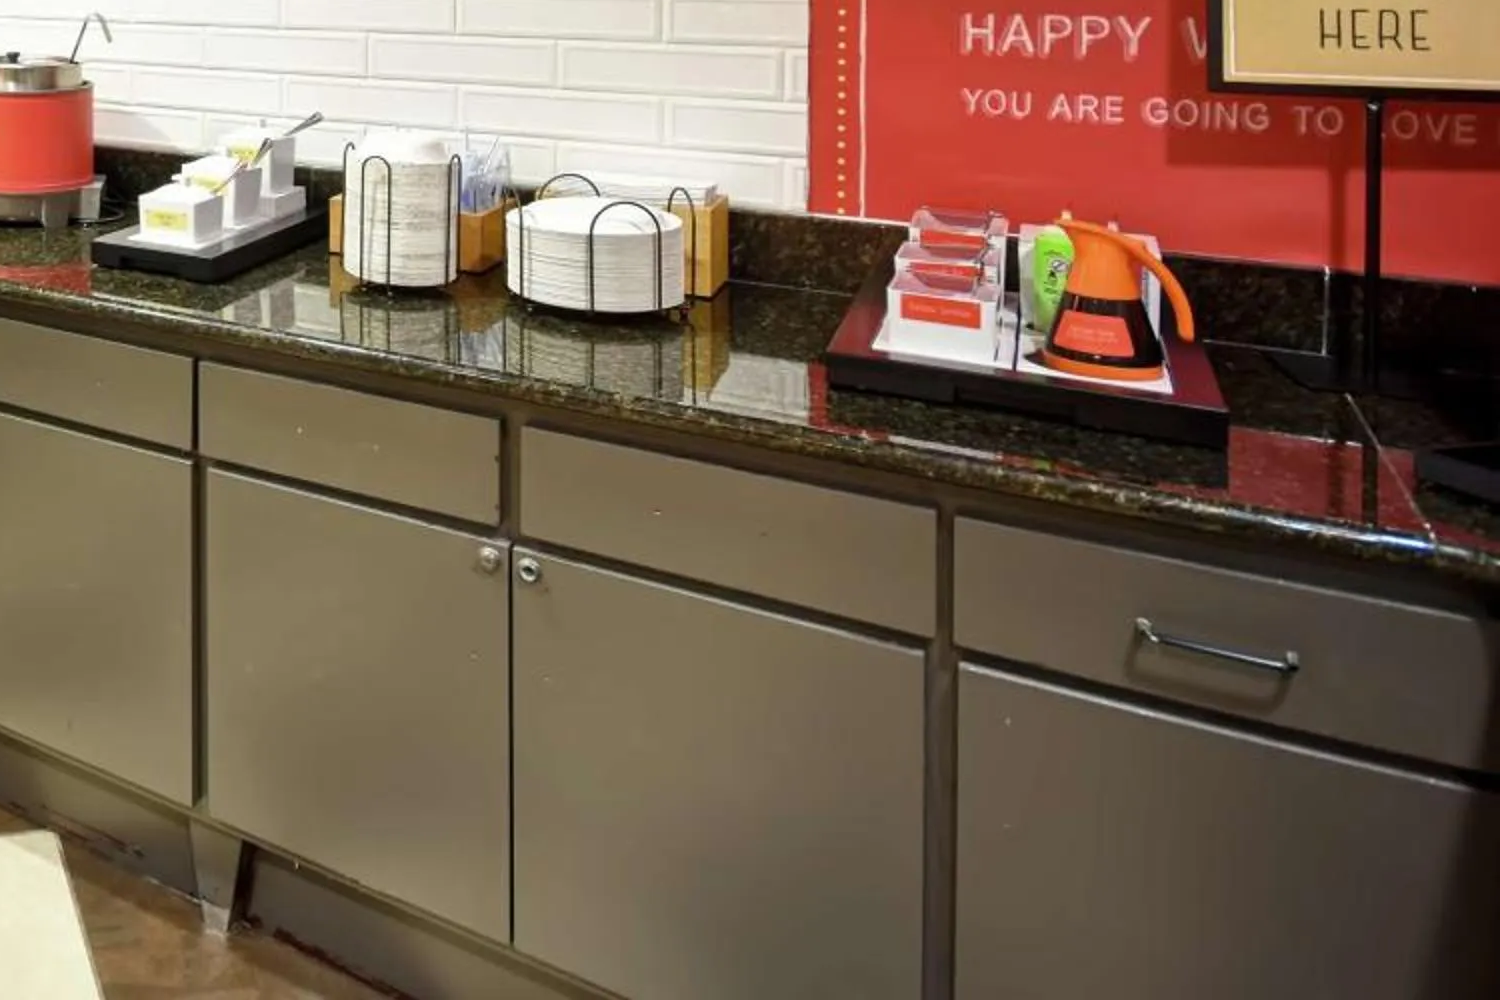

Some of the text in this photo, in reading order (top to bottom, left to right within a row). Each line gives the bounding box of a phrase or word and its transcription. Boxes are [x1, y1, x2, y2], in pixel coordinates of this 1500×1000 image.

[960, 12, 1152, 62] HAPPY
[1319, 8, 1431, 51] HERE
[962, 87, 1478, 146] YOU ARE GOING TO OVE
